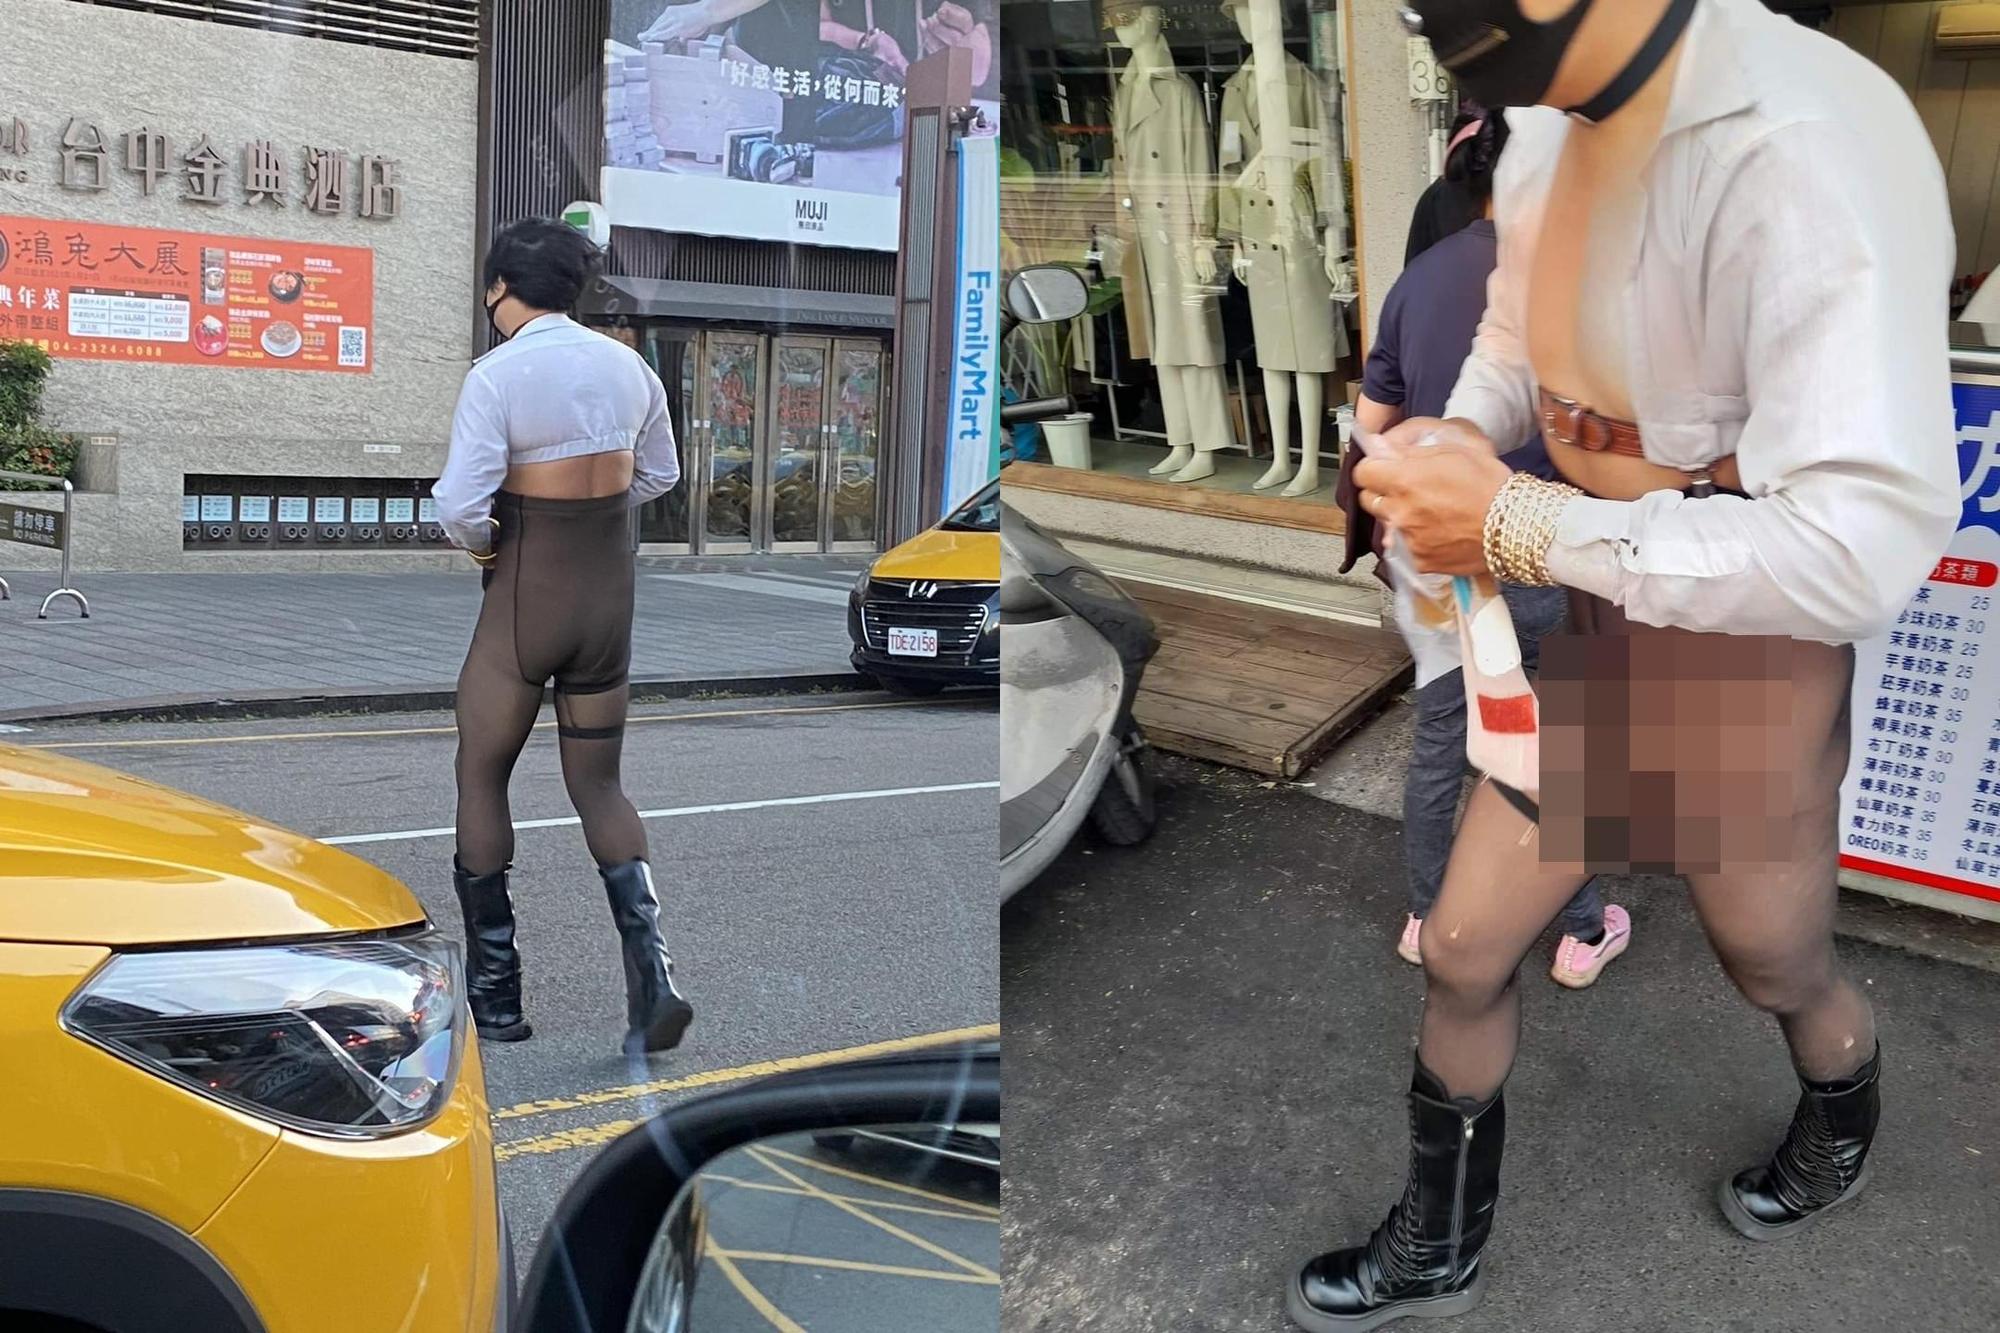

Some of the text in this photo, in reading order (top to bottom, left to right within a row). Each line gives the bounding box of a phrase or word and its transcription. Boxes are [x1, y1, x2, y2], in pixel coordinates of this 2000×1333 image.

[58, 116, 400, 217] 台中金典酒店
[795, 199, 828, 220] MUJI
[15, 230, 189, 276] 鴻兔大展
[959, 271, 992, 441] FamilyMart
[1933, 562, 1979, 582] 茶類
[1970, 595, 1991, 611] 25
[1964, 619, 1986, 634] 30
[890, 634, 936, 652] TDE-2158
[1960, 642, 1980, 657] 25
[1955, 664, 1974, 679] 25
[1950, 687, 1970, 701] 30
[1944, 708, 1963, 722] 35
[1939, 729, 1958, 743] 30
[1867, 738, 1954, 764] 布丁奶茶 30
[1927, 770, 1946, 784] 30
[1923, 790, 1942, 804] 30
[1855, 796, 1937, 823] 仙草奶茶 35
[1851, 815, 1933, 842] 魔力奶茶 35
[1847, 833, 1929, 861] OREO奶茶 35
